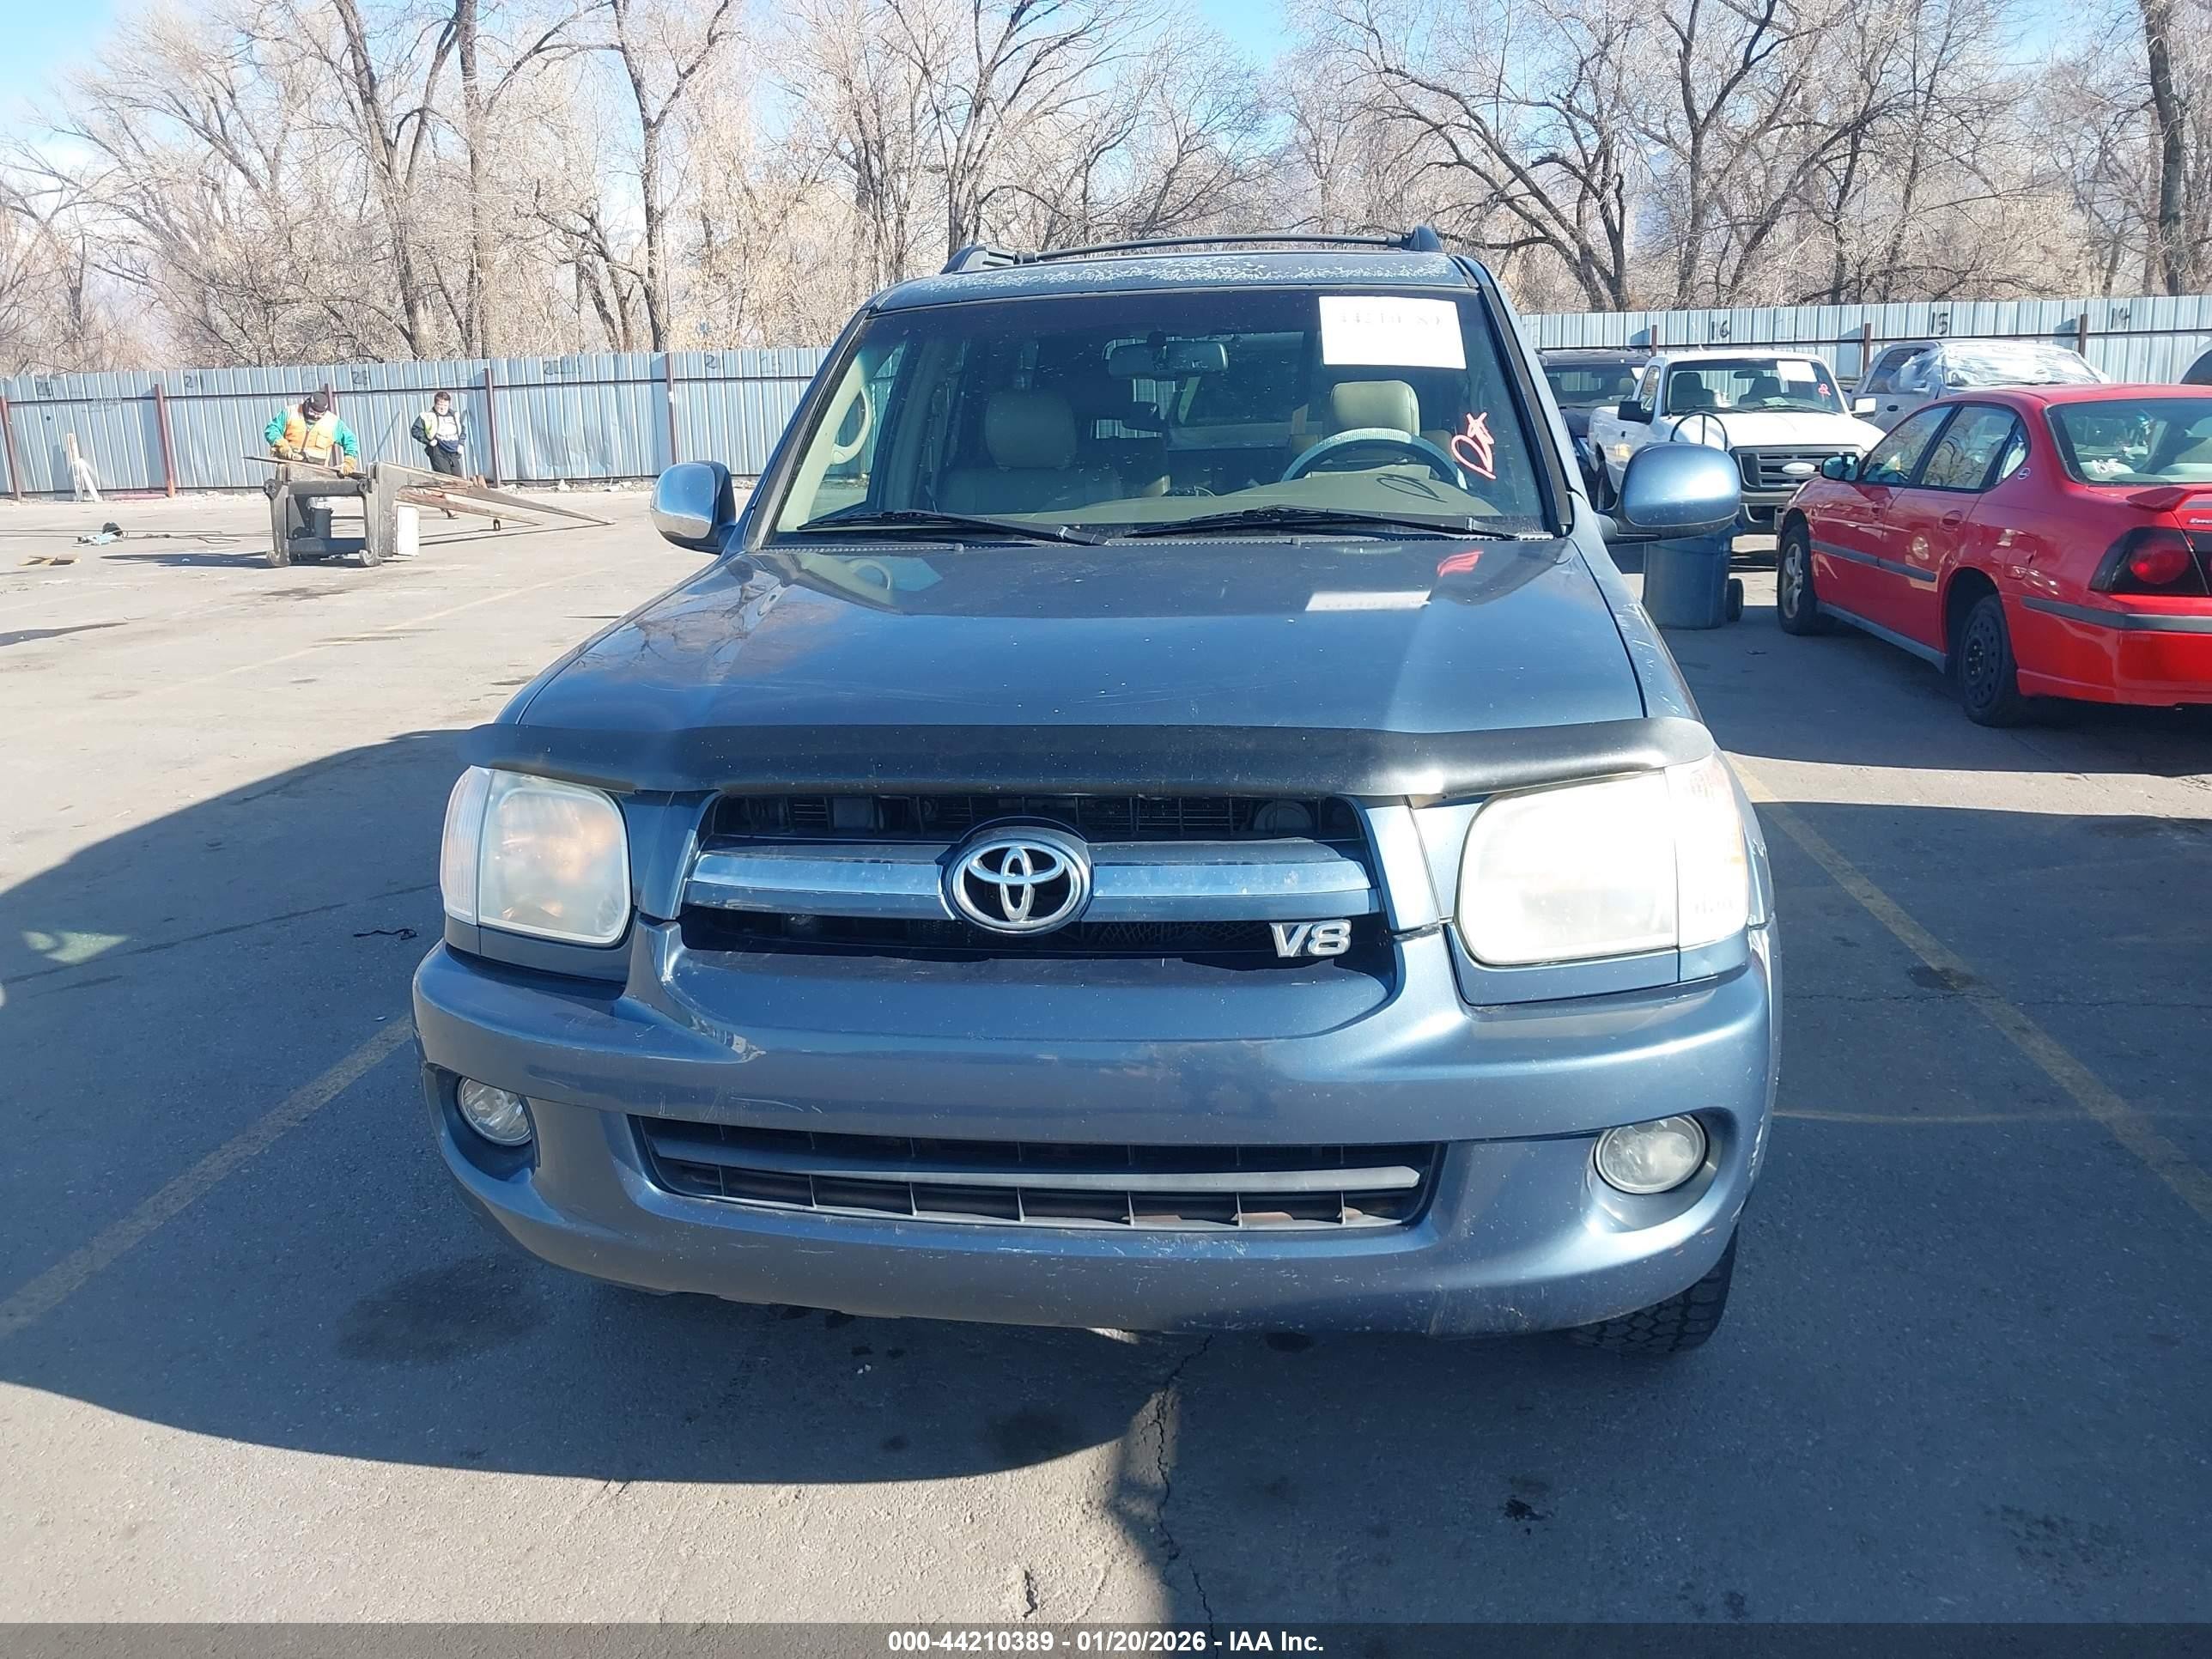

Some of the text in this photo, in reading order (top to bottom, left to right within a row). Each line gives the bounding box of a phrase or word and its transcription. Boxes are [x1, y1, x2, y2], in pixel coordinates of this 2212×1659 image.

[1930, 312, 1949, 336] 15
[2110, 307, 2130, 330] 14
[1711, 320, 1730, 341] 16
[1269, 919, 1352, 958] V8
